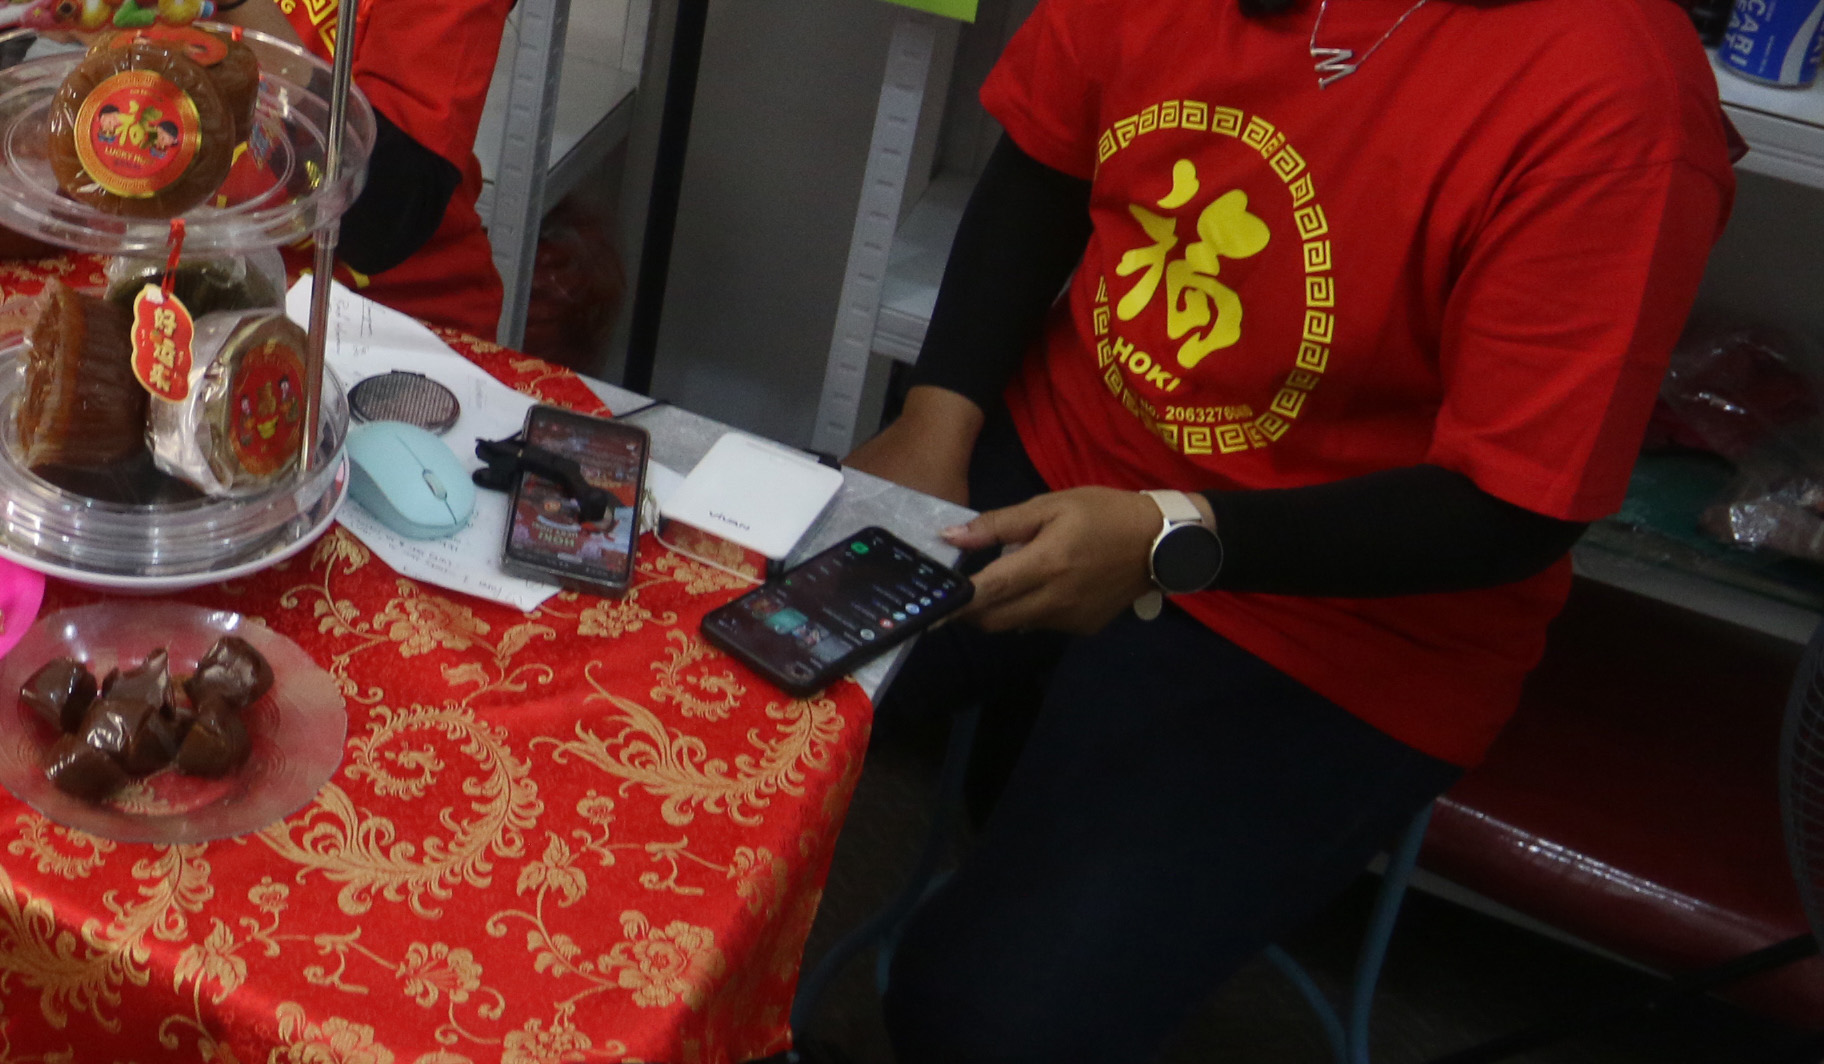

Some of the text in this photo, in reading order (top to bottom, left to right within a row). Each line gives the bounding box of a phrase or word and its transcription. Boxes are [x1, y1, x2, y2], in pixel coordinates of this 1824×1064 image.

[114, 100, 164, 150] 福
[105, 147, 133, 161] LUCKY
[1116, 158, 1270, 369] 福
[1112, 336, 1181, 392] HOKI
